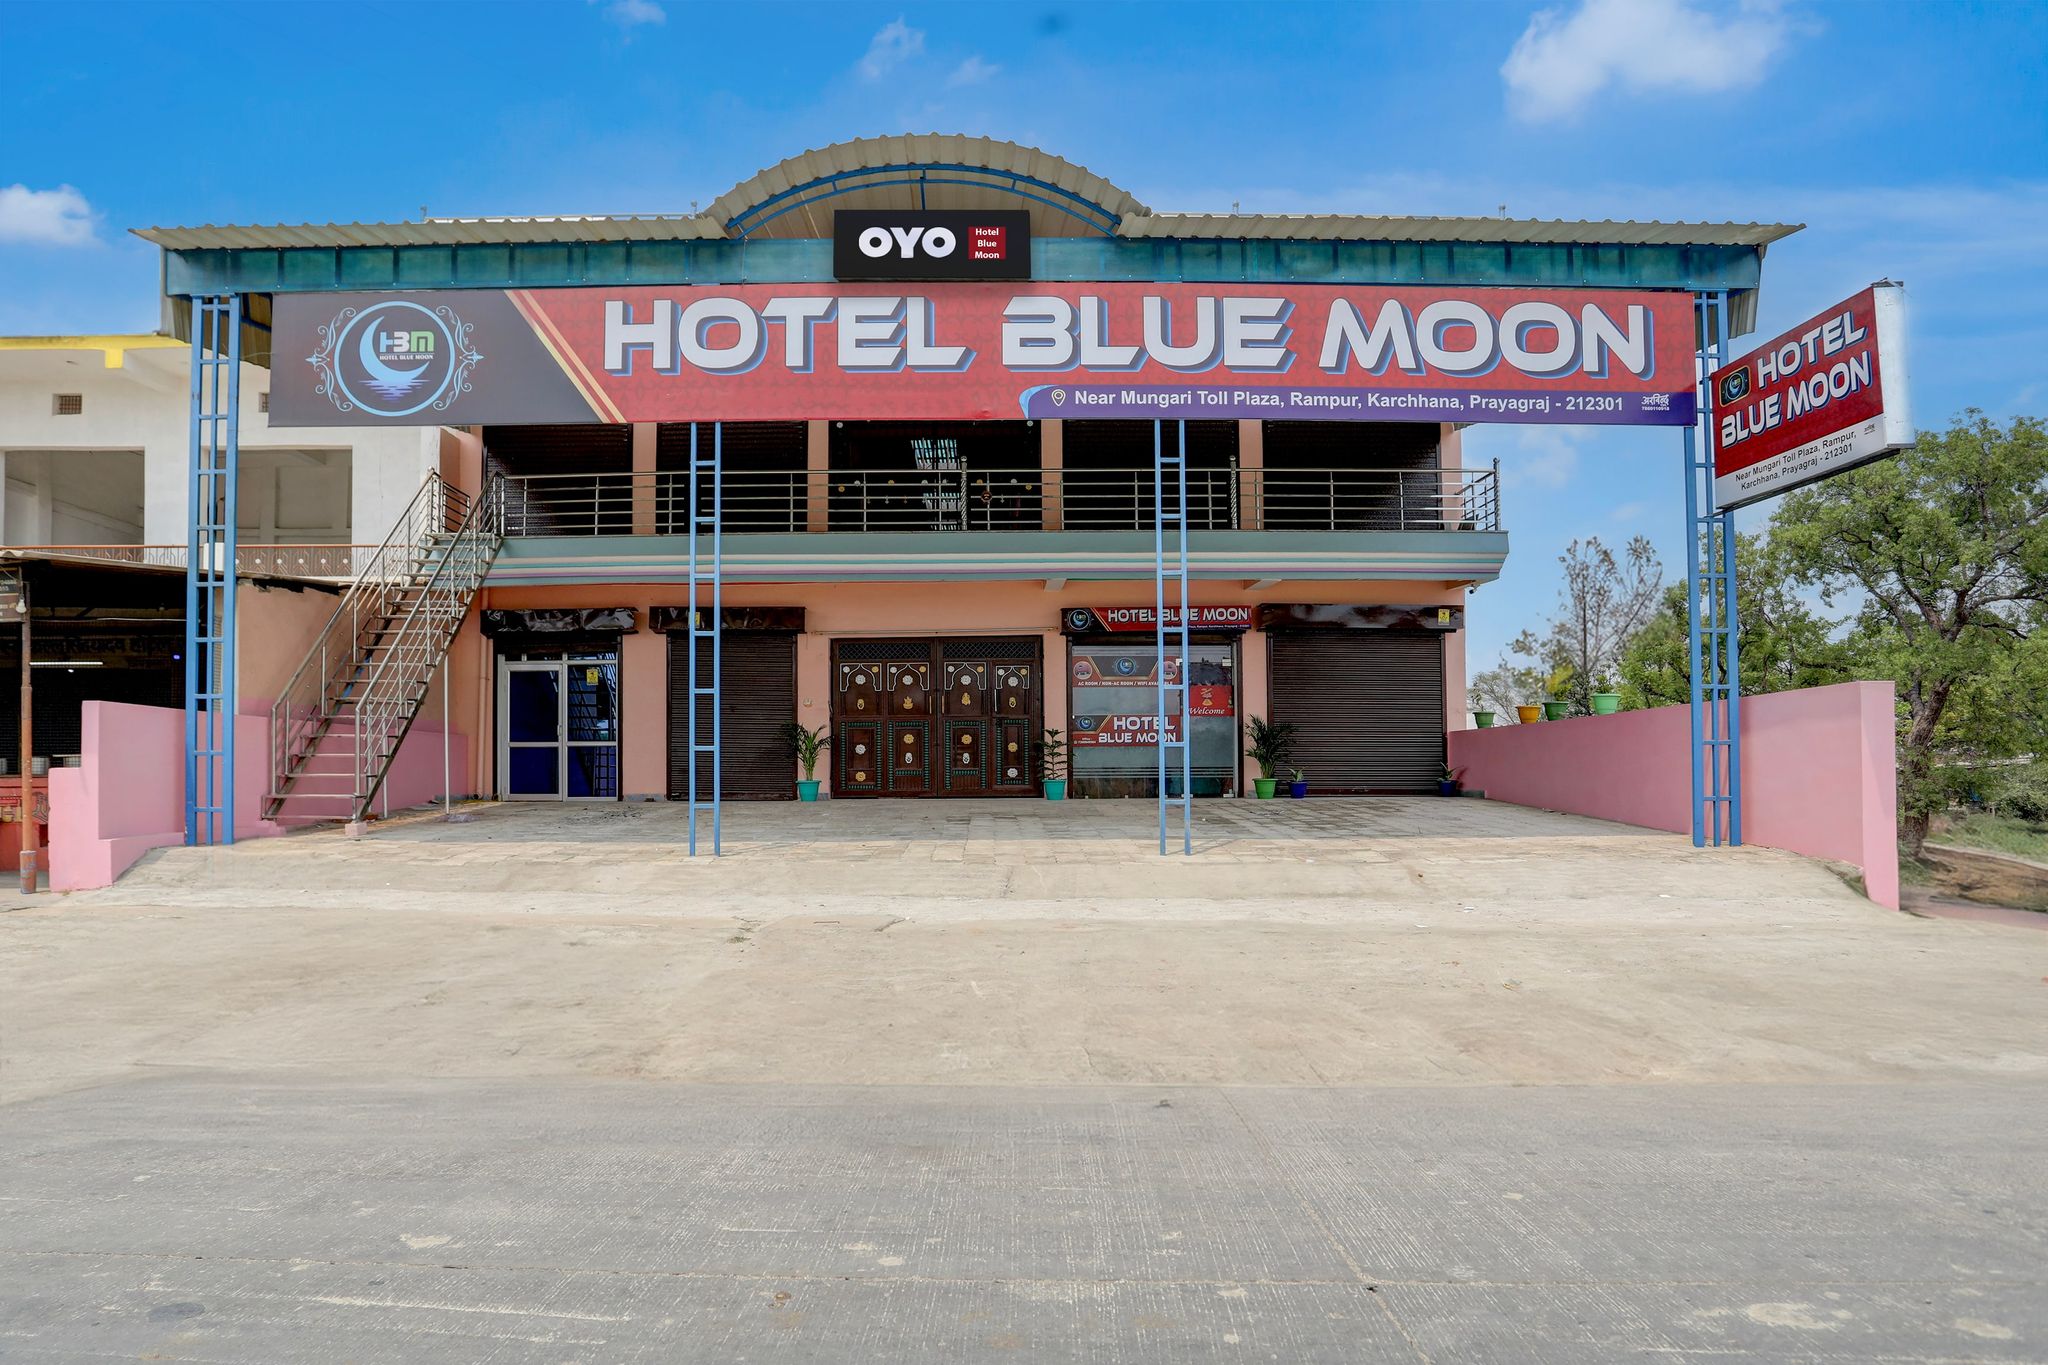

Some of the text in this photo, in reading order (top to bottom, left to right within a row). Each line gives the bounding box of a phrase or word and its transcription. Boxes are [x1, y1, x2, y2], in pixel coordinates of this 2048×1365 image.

[975, 228, 1000, 236] Hotel
[858, 226, 957, 259] OYO
[977, 240, 997, 248] Blue
[975, 251, 1000, 259] Moon
[604, 296, 1655, 381] HOTEL BLUE MOON
[1757, 311, 1868, 389] HOTEL
[1075, 390, 1116, 405] Near
[1121, 390, 1192, 408] Mungari
[1197, 390, 1228, 405] Toll
[1234, 391, 1285, 408] Plaza,
[1290, 392, 1362, 409] Rampur,
[1367, 393, 1464, 411] Karchhana,
[1470, 395, 1550, 412] Prayagraj
[1565, 397, 1623, 411] 212301
[1721, 350, 1872, 448] BLUE MOON
[1735, 430, 1857, 482] Near Mungari Toll Plaza, Rampur,
[1741, 472, 1780, 490] Karchhana,
[1782, 457, 1818, 476] Prayagraj
[1824, 443, 1853, 460] 212301
[1108, 608, 1157, 622] HOTEL
[1203, 607, 1248, 621] MOON
[1189, 706, 1225, 715] Welcome
[1113, 716, 1175, 730] HOTEL
[1098, 732, 1132, 743] BLUE
